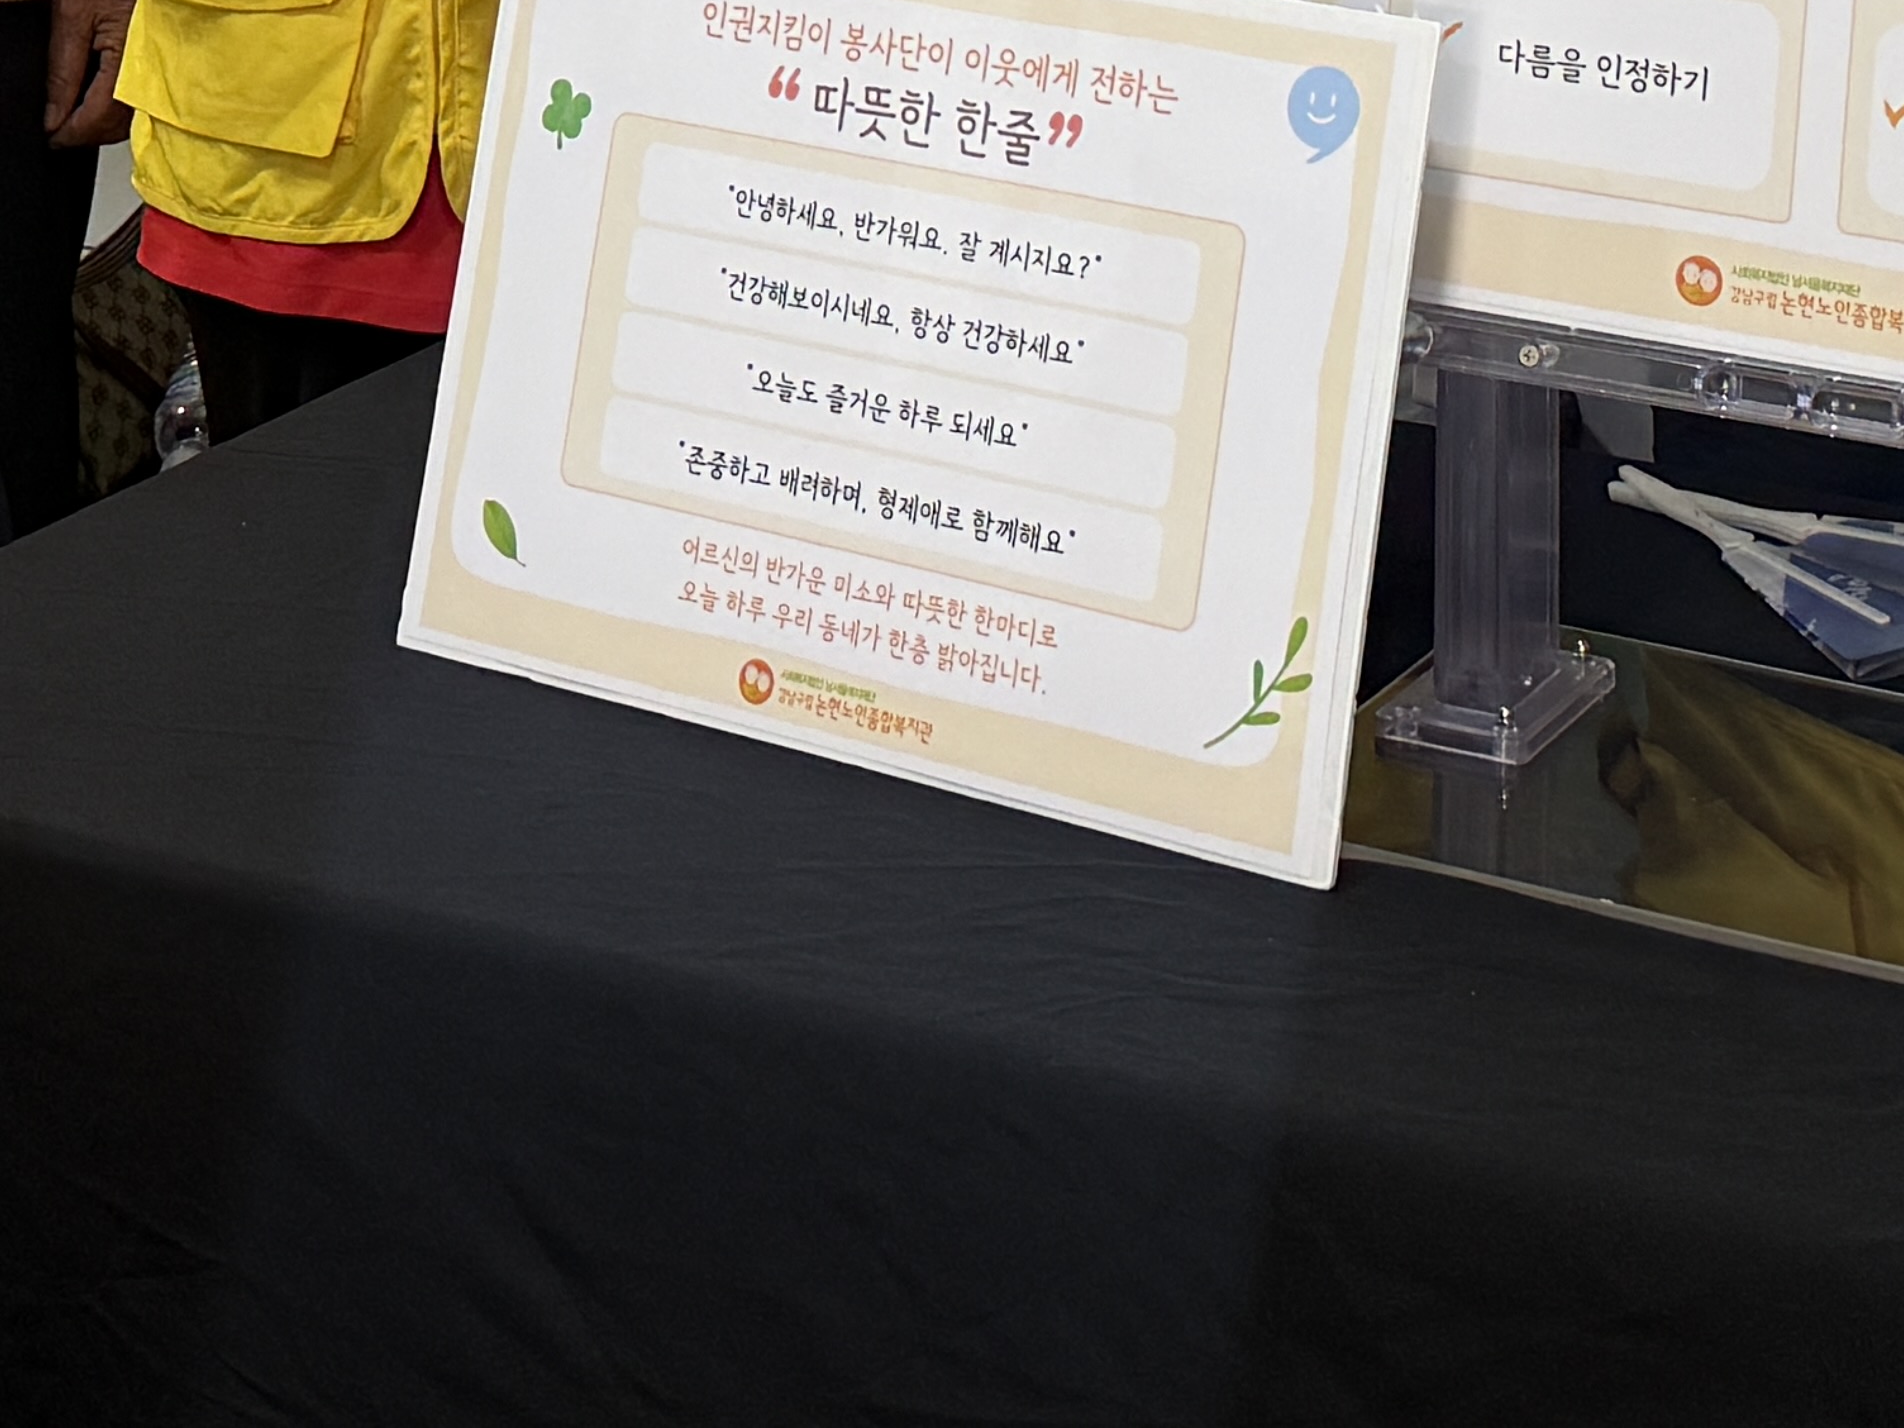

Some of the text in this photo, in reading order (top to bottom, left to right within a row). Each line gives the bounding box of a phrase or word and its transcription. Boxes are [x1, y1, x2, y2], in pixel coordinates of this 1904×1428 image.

[704, 1, 1178, 115] 인권지킴이 봉사단이 이웃에게 전하는
[1500, 40, 1708, 101] 다름을 인정하기
[855, 212, 947, 254] 반가워요.
[960, 232, 981, 262] 잘
[912, 307, 955, 343] 항상
[826, 384, 891, 424] 즐거운
[900, 400, 942, 433] 하루
[780, 467, 865, 513] 배려하며,
[879, 487, 963, 530] 형제애로
[683, 536, 1057, 648] 어르신의 반가운 미소와 따뜻한 한마디로
[678, 581, 1045, 694] 오늘 하루 우리 동네가 한층 밝아집니다.
